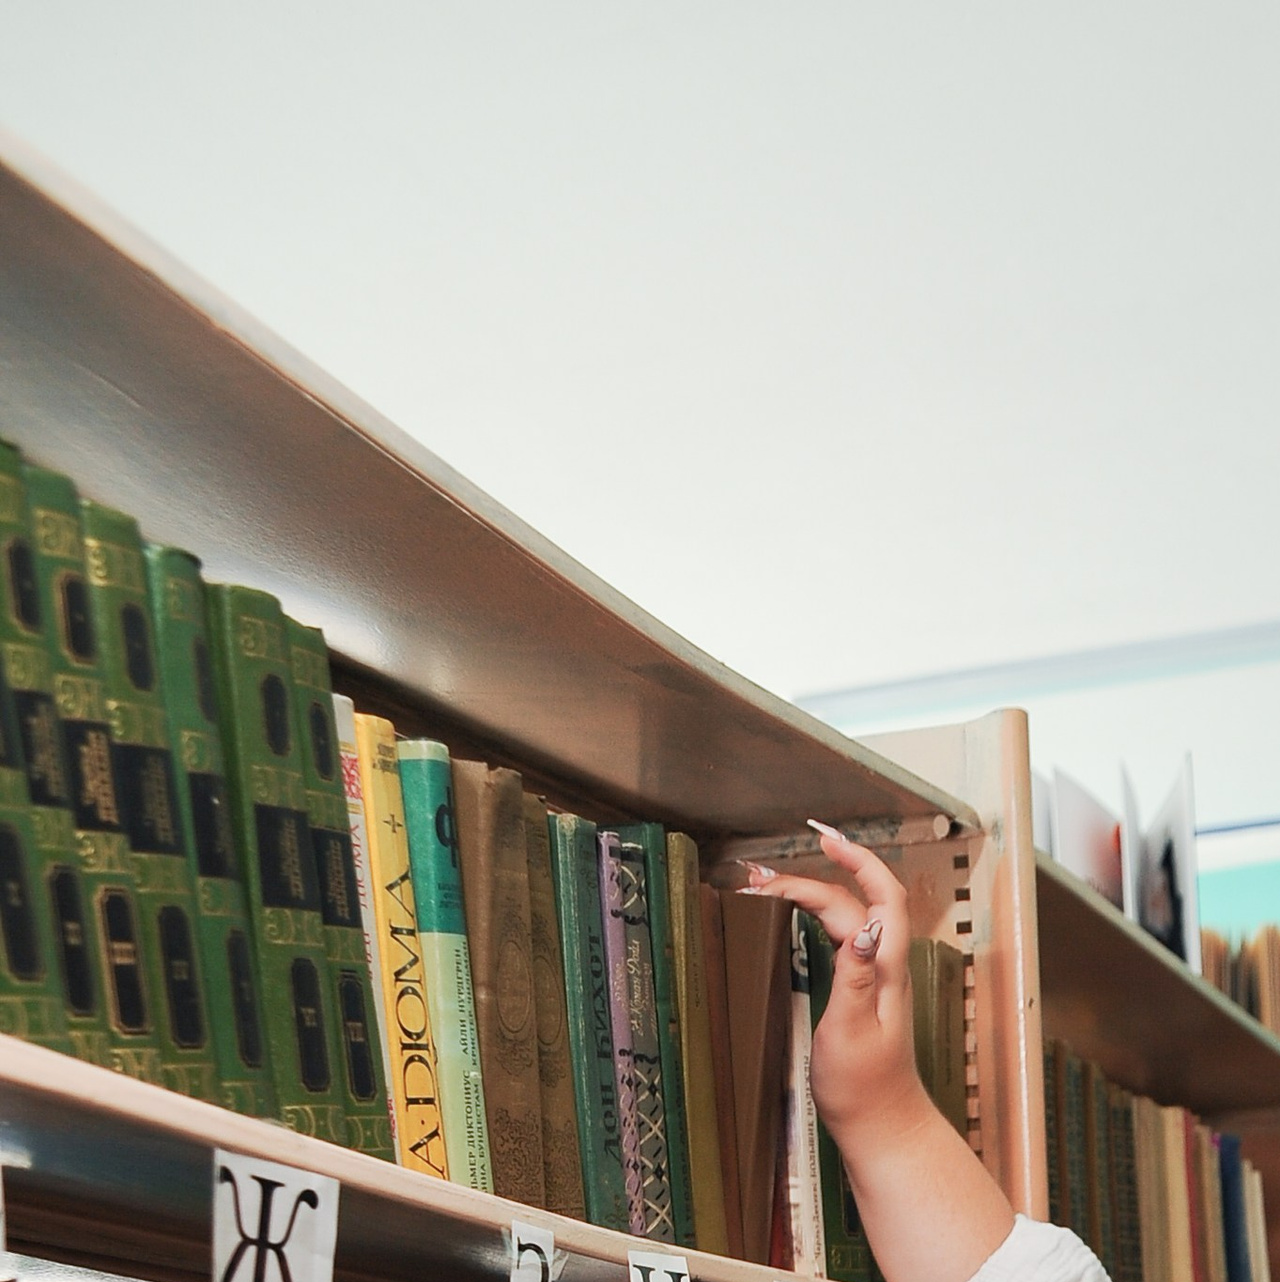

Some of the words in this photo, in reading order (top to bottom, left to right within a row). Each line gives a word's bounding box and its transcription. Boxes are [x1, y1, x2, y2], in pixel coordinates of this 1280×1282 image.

[453, 949, 466, 1013] НУРДГРЕН
[586, 926, 611, 1060] КИХОТ
[458, 1019, 468, 1055] АЙЛИ
[461, 1070, 476, 1149] ДИКТОНИУС
[599, 1082, 622, 1167] ДОН
